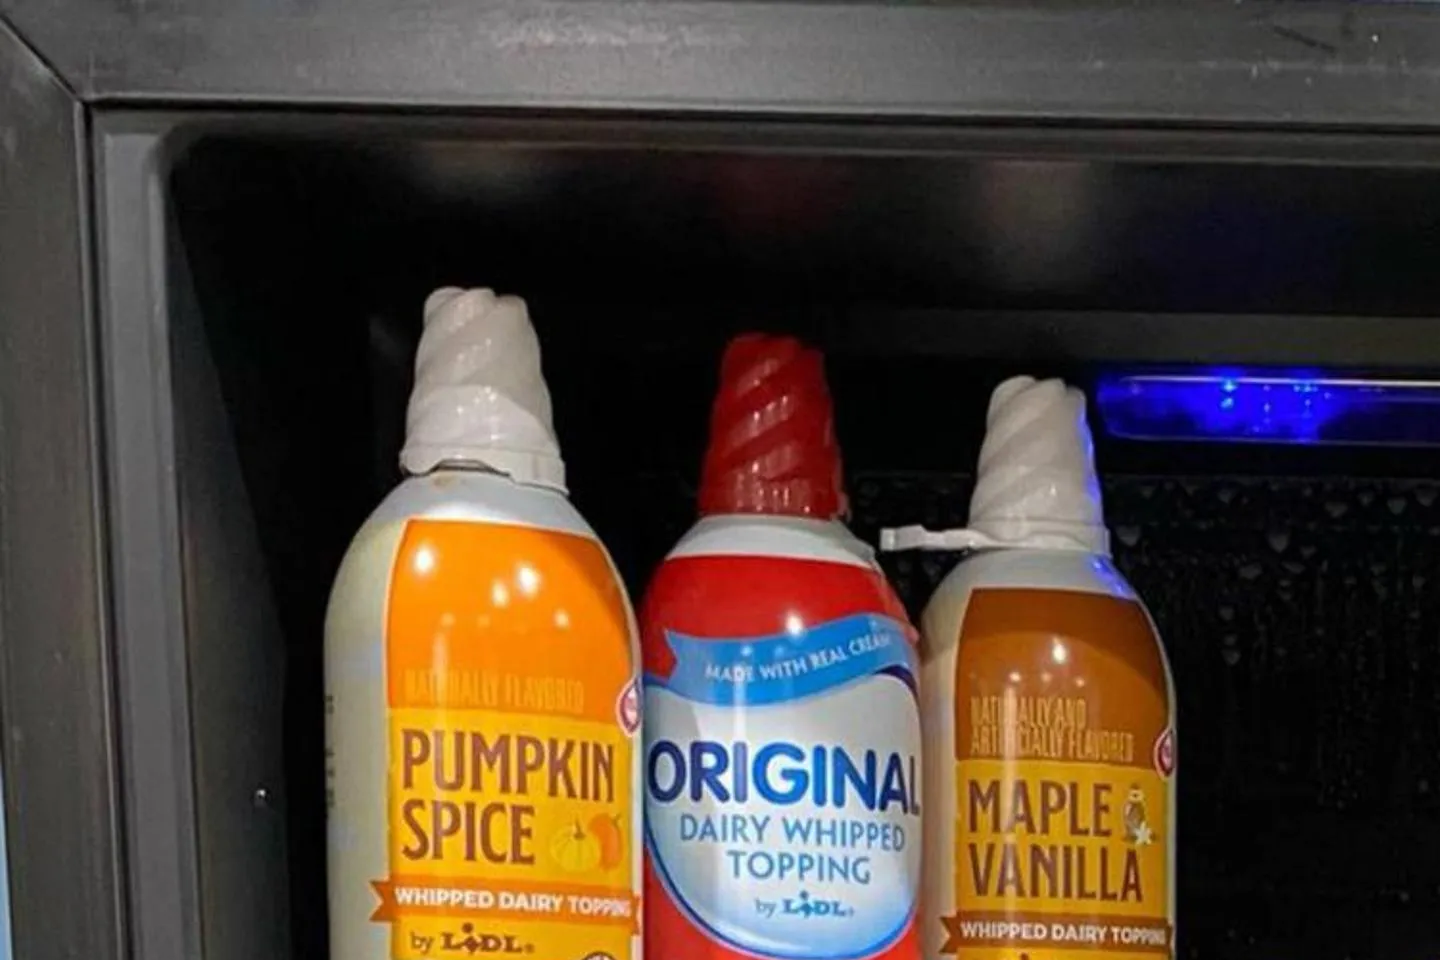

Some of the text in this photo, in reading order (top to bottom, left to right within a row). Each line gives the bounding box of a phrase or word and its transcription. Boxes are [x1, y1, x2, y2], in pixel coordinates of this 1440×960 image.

[705, 633, 892, 684] MADE WITH REAL CREAM
[970, 695, 1053, 726] NATALLY
[970, 723, 1063, 758] ARTCIALLY
[401, 728, 615, 804] PUMPKIN
[647, 739, 920, 817] ORIGINAL
[968, 779, 1114, 838] MAPLE
[401, 799, 536, 866] SPICE
[680, 813, 906, 853] DAIRY WHIPPED
[727, 849, 871, 886] TOPPING
[968, 842, 1144, 903] VANILLA
[395, 886, 494, 909] WHIPPED
[498, 890, 563, 913] DAIRY
[755, 897, 778, 921] by
[410, 931, 434, 955] by
[960, 920, 1048, 940] WHIPPED
[1051, 923, 1107, 942] DAIRY
